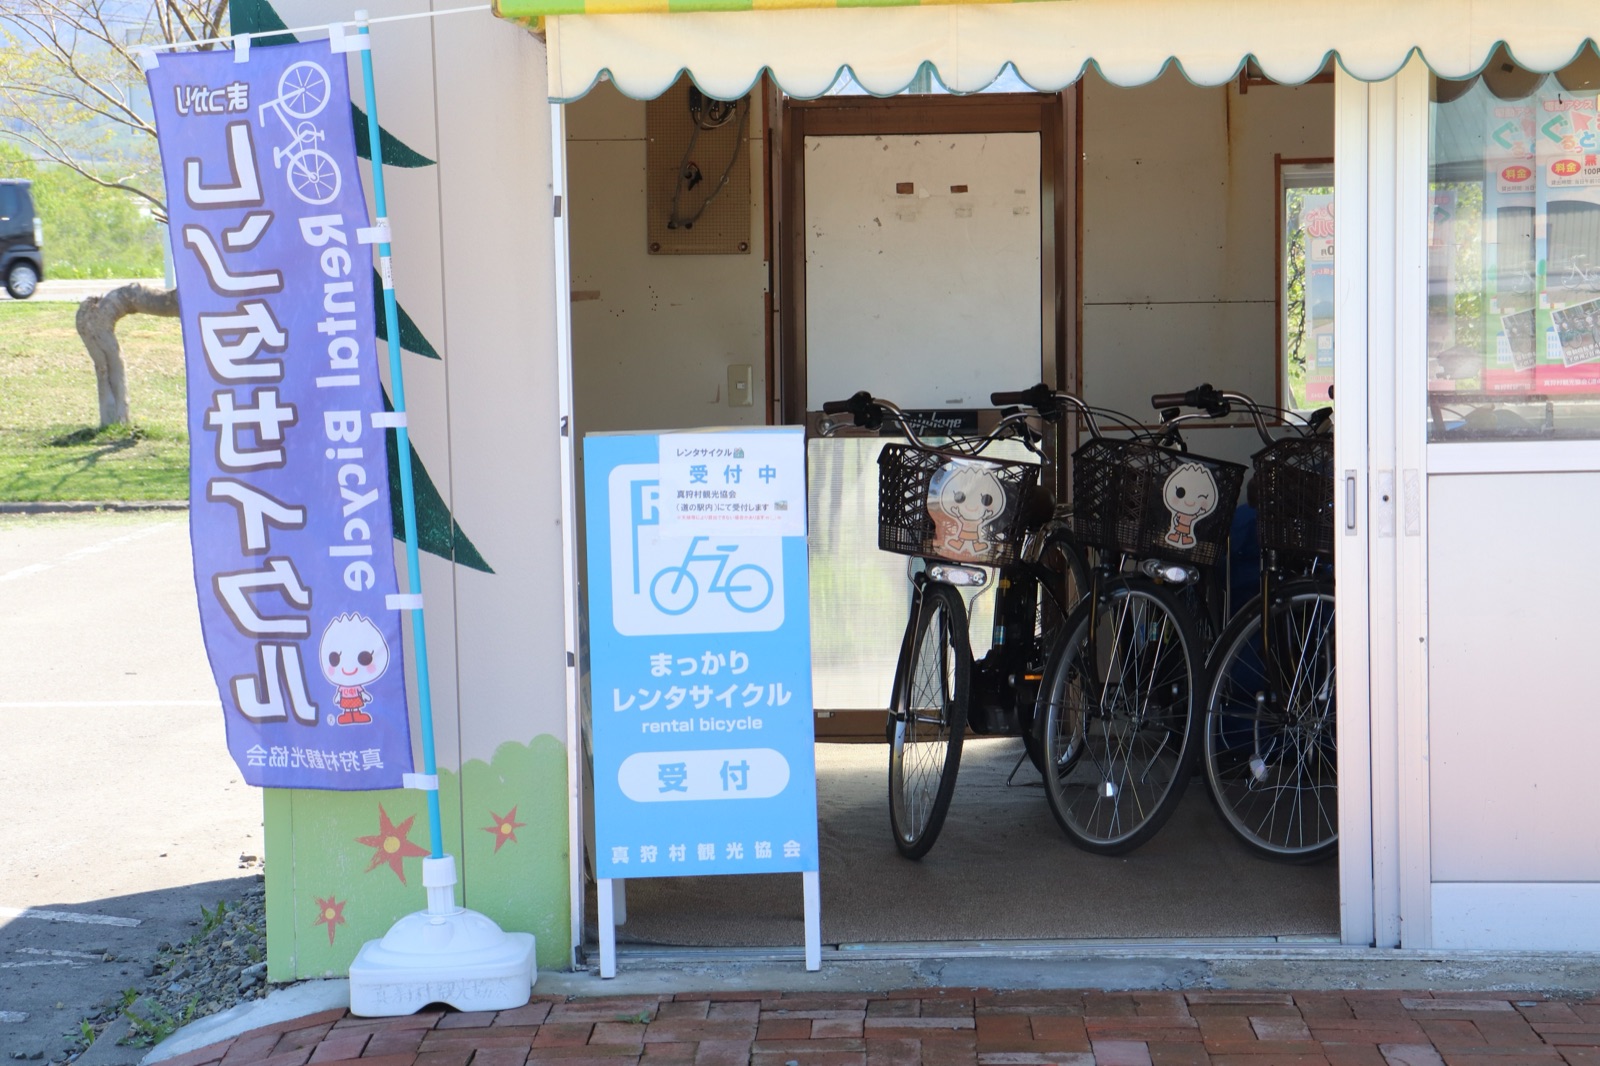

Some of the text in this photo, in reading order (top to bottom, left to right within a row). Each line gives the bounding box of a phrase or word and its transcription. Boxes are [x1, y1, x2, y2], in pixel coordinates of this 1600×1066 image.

[1506, 169, 1527, 179] 料金
[1555, 162, 1577, 173] 料金
[676, 448, 733, 457] レンタサイクル
[689, 464, 777, 484] 受付中
[676, 489, 737, 499] 真狩村観光協会
[649, 650, 750, 677] まっかり
[612, 682, 793, 713] レンタサイクル
[641, 716, 764, 734] rental bicycle
[657, 759, 751, 794] 受付
[611, 839, 802, 865] 真狩村観光協会
